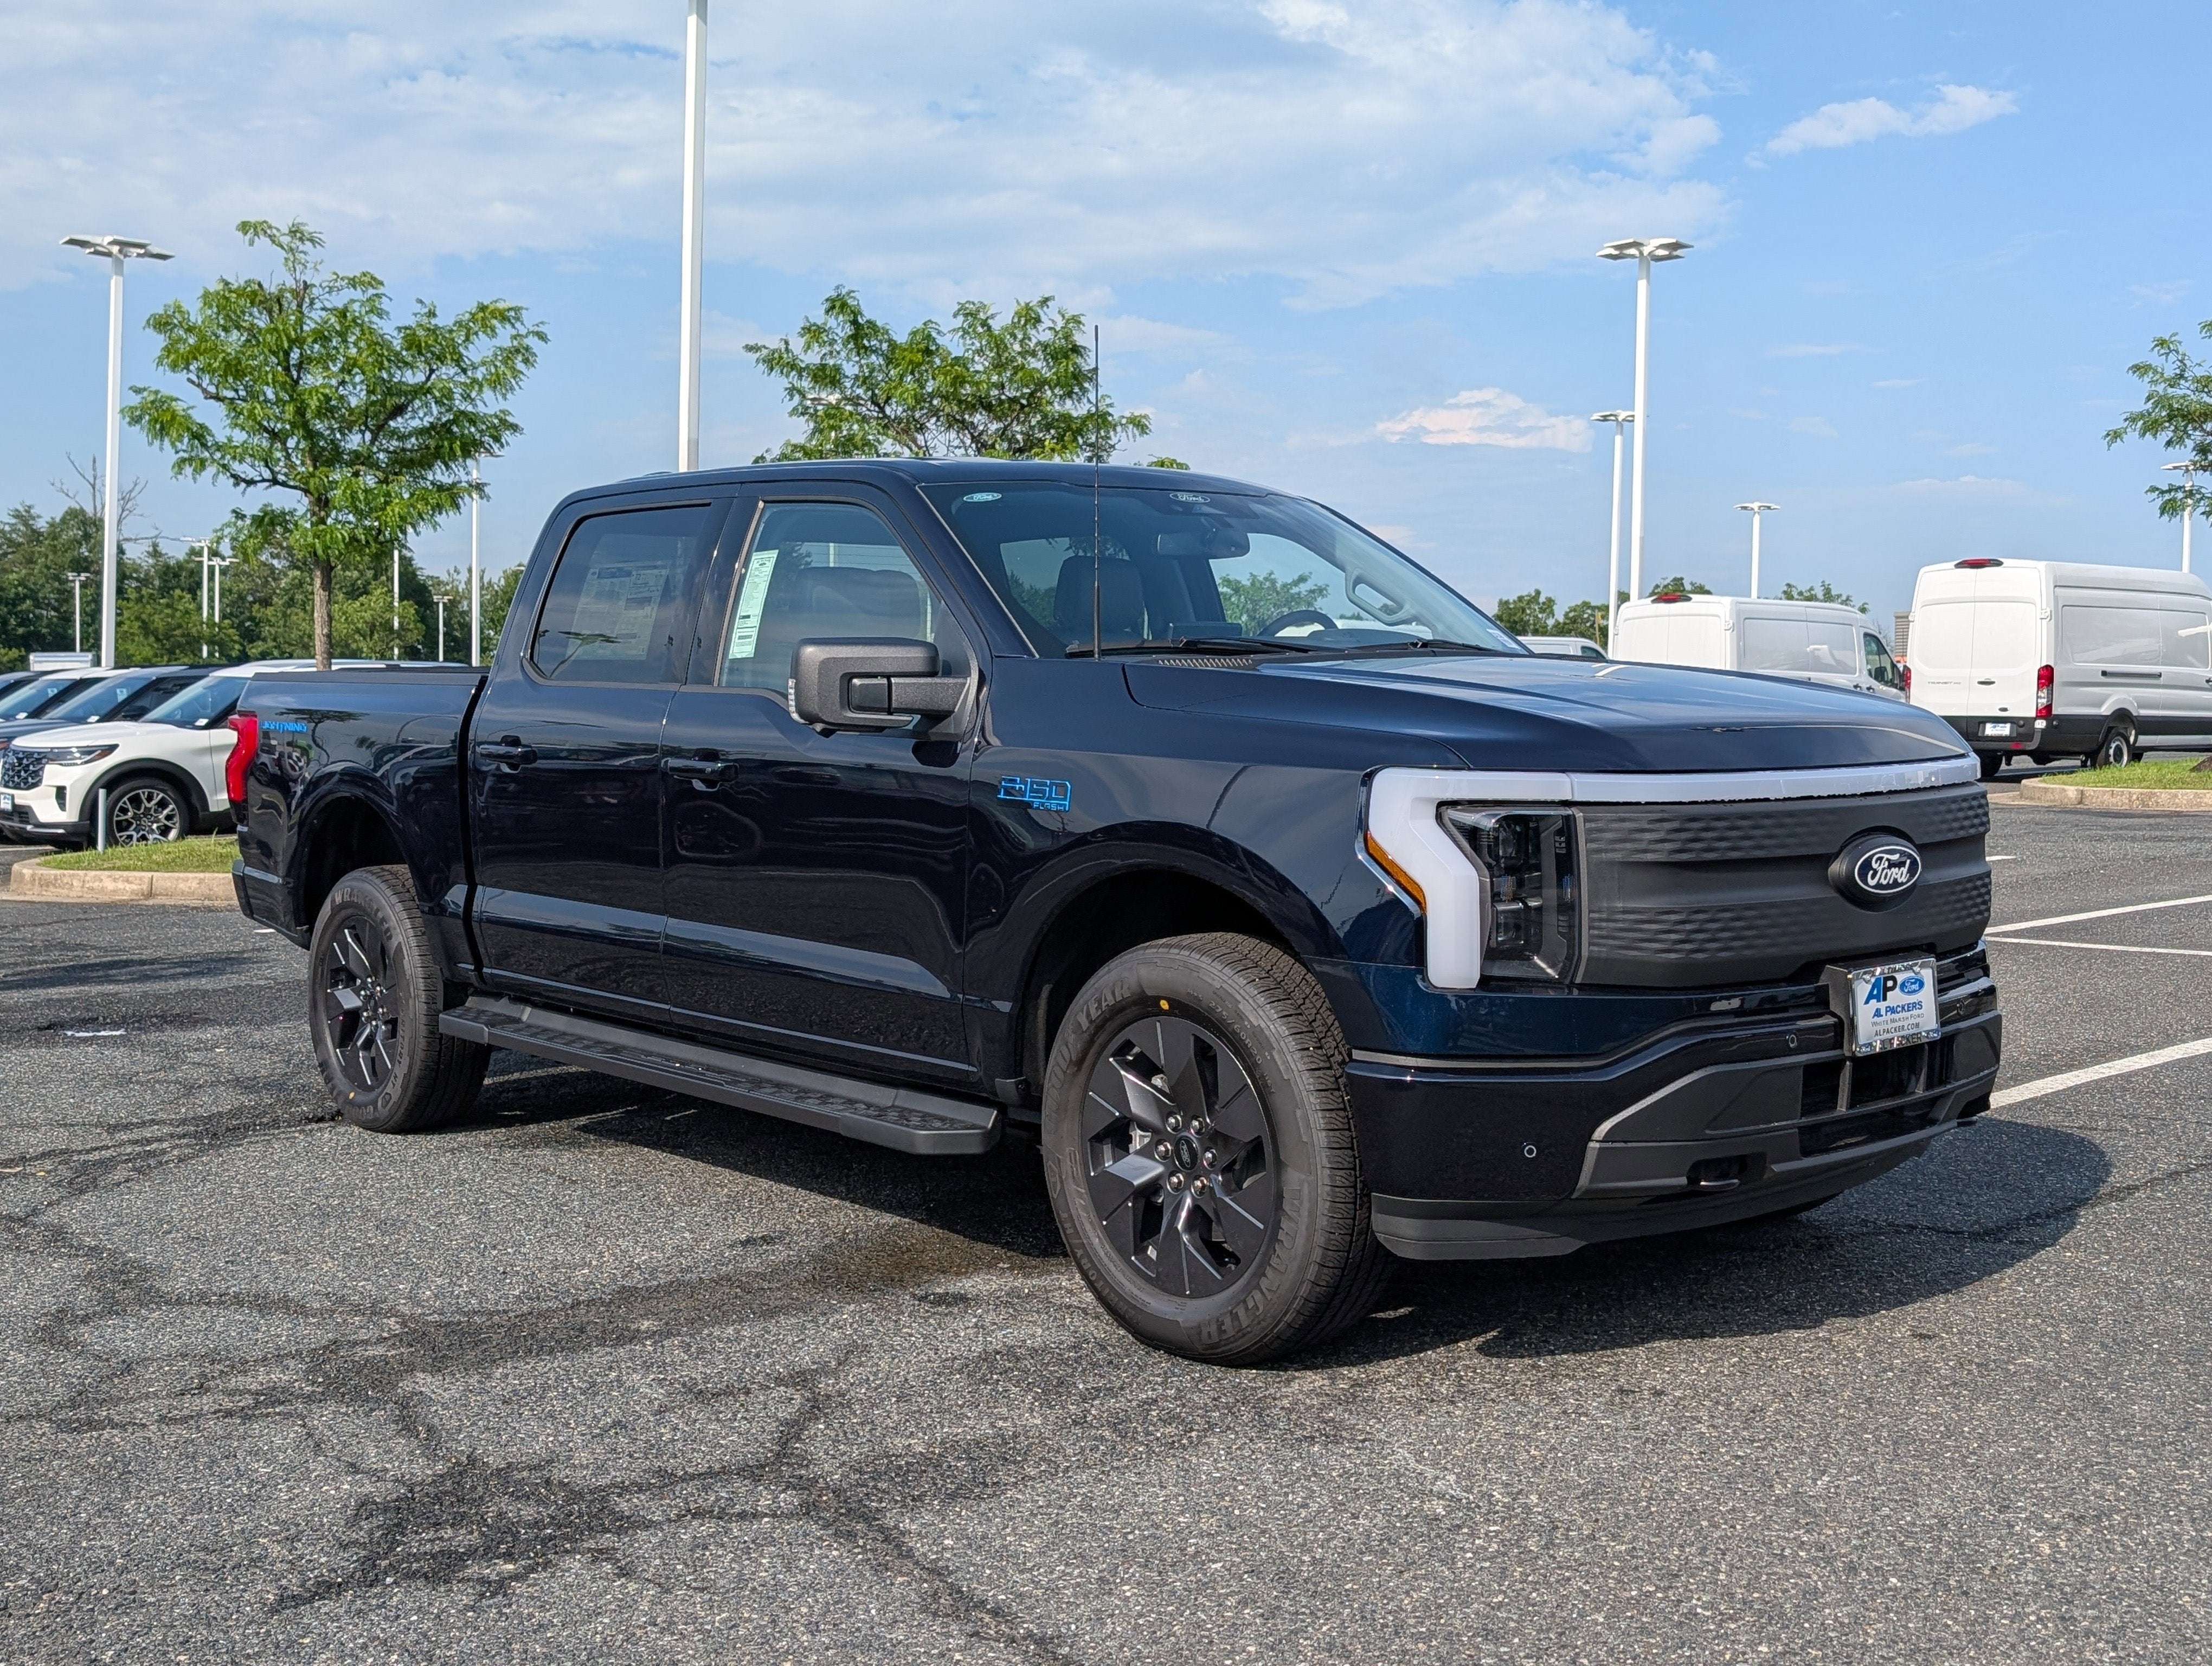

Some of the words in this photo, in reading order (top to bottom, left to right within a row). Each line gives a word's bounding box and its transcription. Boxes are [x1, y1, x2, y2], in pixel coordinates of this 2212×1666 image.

[1033, 802, 1064, 811] FLASH
[1868, 853, 1911, 886] Ford
[1863, 975, 1898, 1005] AP
[1872, 1008, 1883, 1019] AL
[1885, 999, 1923, 1016] PACKER'S
[1209, 1001, 1263, 1065] 275/60R20
[1874, 1022, 1920, 1037] ALPACKER.COM
[1200, 1187, 1301, 1346] WRANGLER
